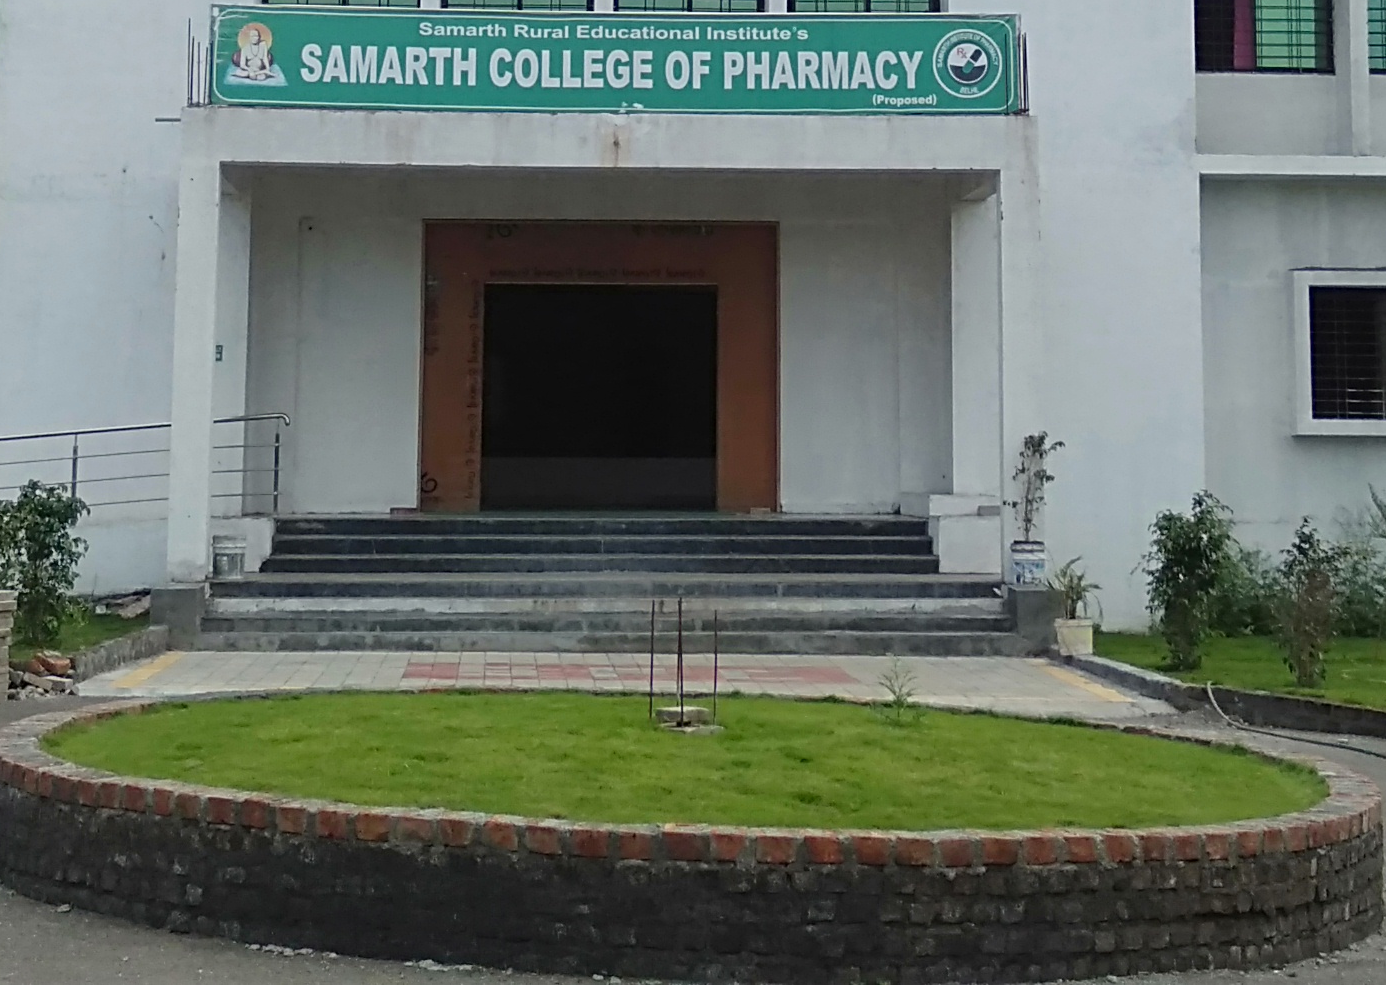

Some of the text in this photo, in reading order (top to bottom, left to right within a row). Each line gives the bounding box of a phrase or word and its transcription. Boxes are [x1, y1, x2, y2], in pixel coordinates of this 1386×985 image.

[419, 22, 809, 41] Samarth Rural Educational Institute's
[300, 43, 924, 90] SAMARTH COLLEGE OF PHARMACY
[872, 93, 938, 107] (Proposed)
